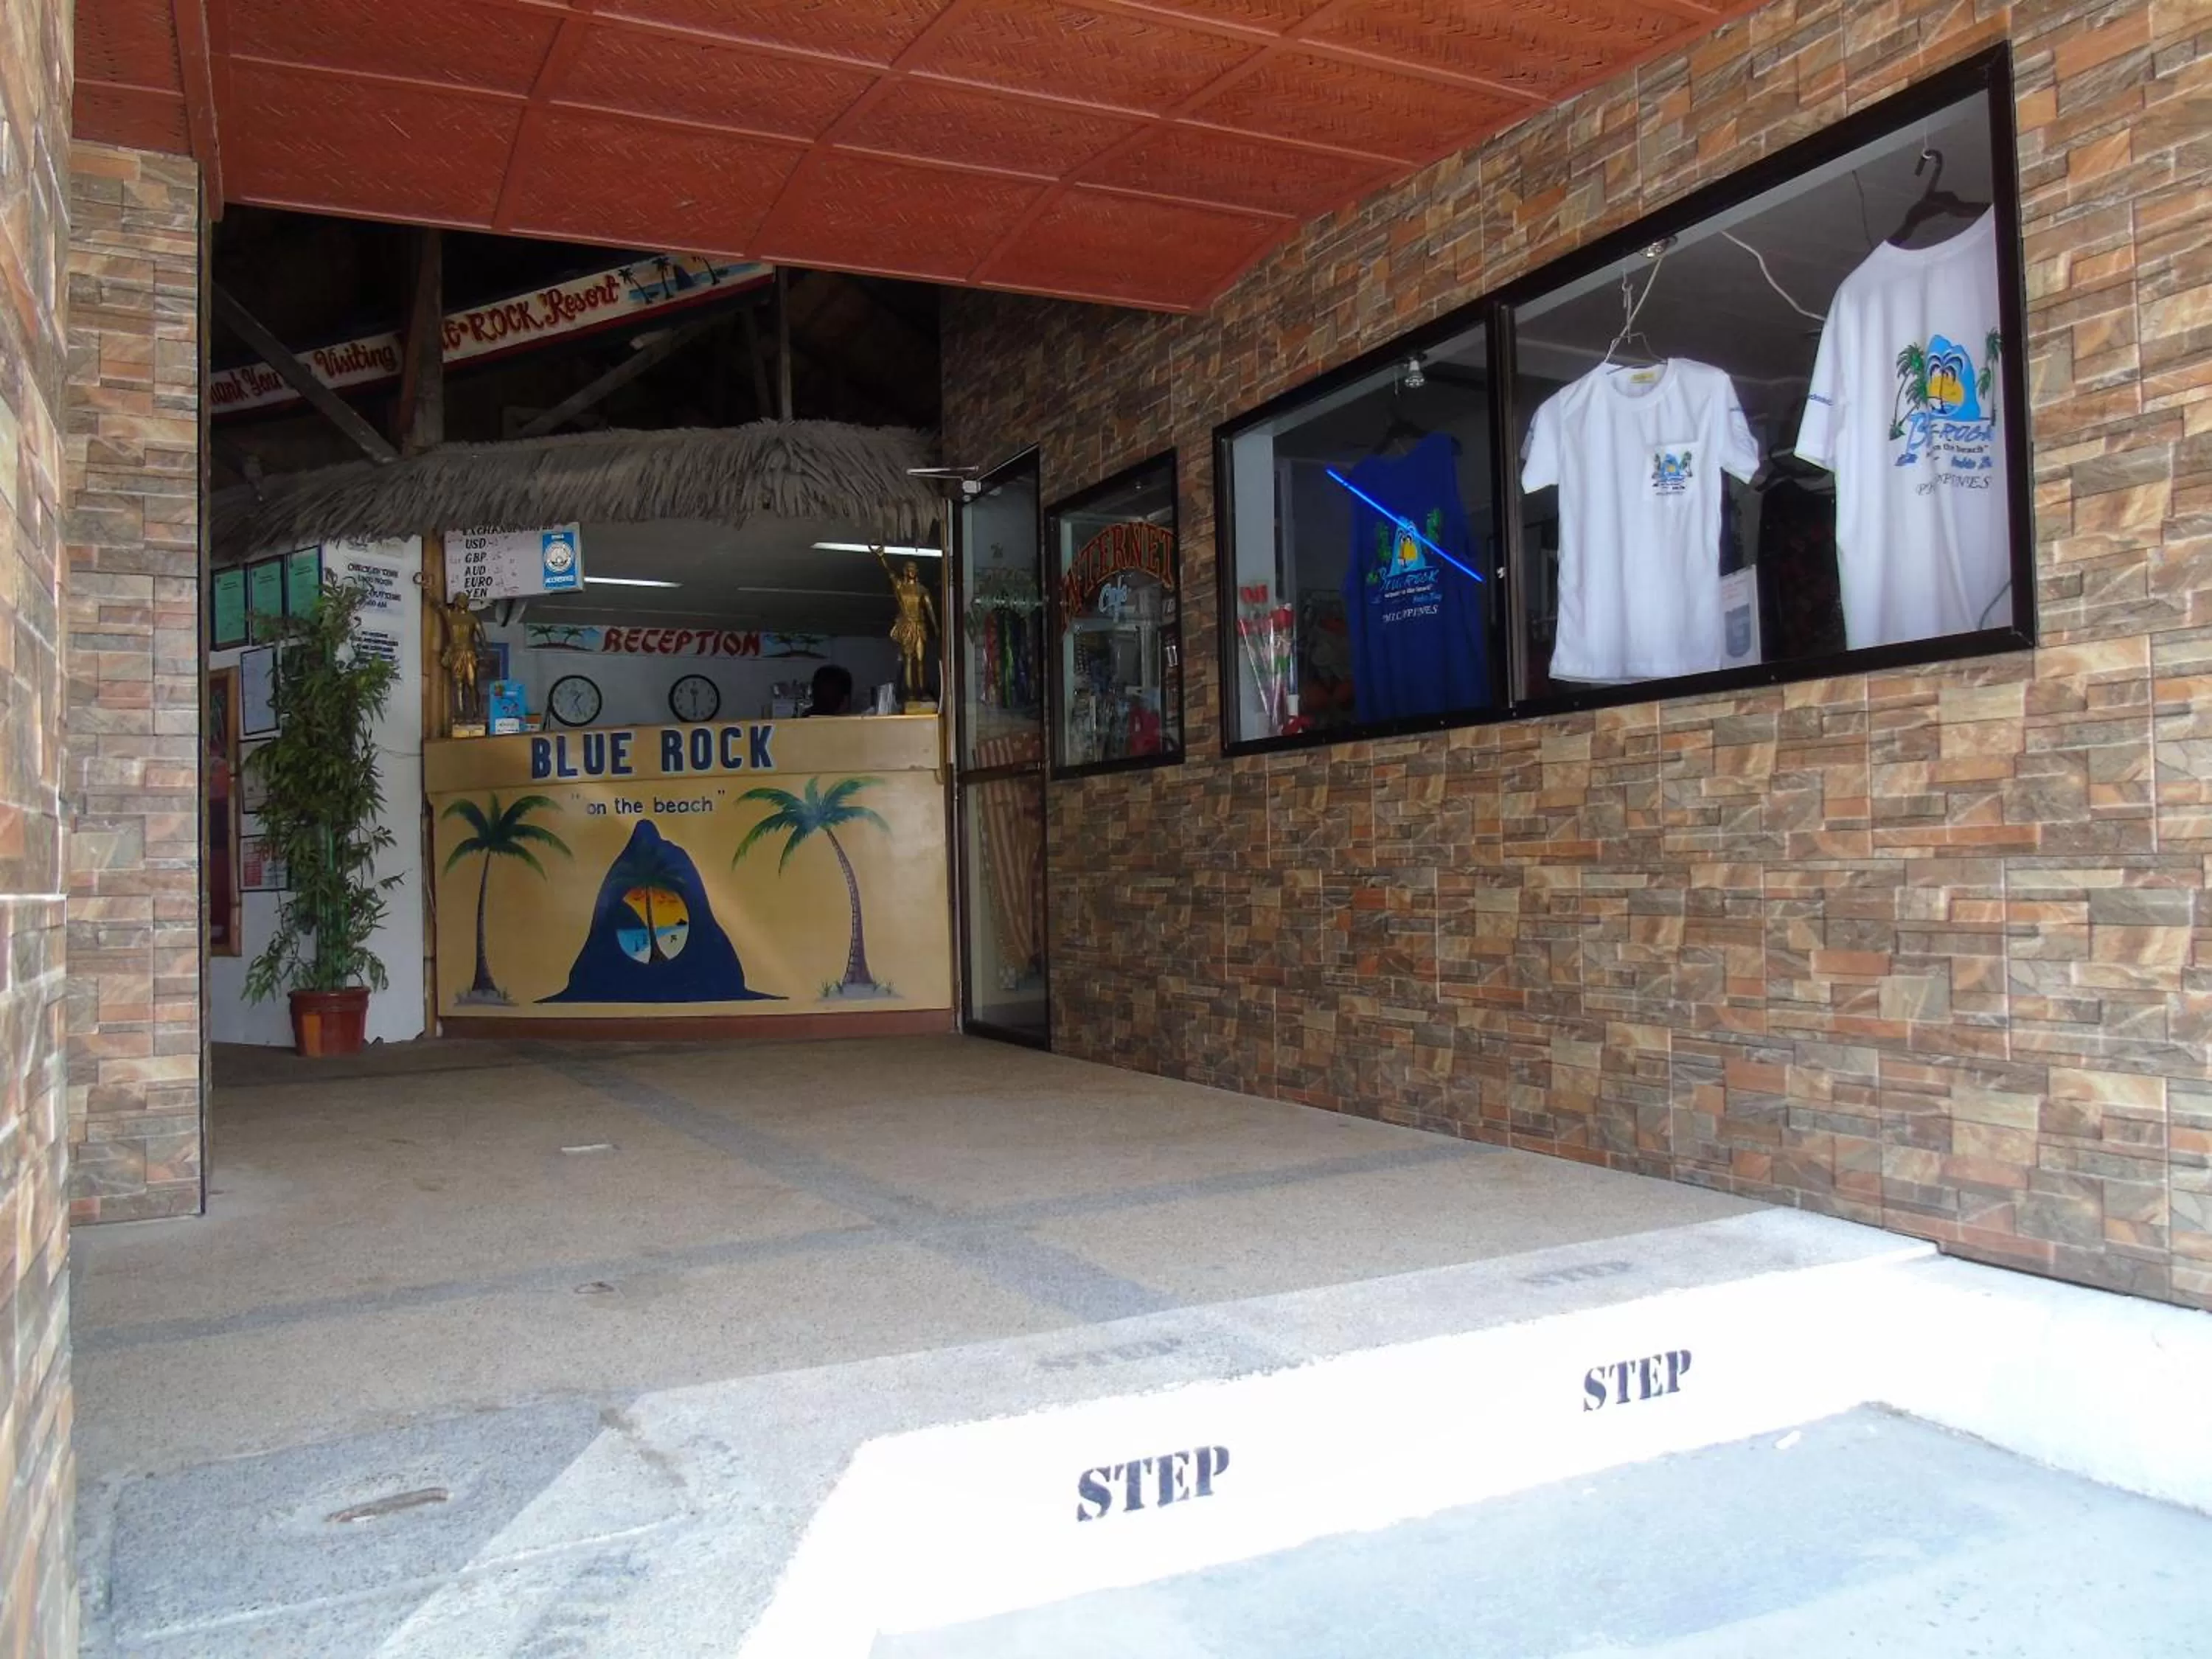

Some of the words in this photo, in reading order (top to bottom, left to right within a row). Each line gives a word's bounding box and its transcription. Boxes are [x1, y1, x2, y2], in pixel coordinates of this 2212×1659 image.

[314, 342, 397, 378] Visiting
[541, 274, 622, 325] Resort
[465, 538, 487, 549] USD
[465, 552, 487, 564] GBP
[464, 566, 487, 577] AUD
[464, 577, 493, 588] EURO
[1060, 521, 1178, 638] INTERNET
[601, 627, 762, 657] RECEPTION
[531, 731, 633, 779] BLUE
[661, 725, 774, 772] ROCK
[614, 797, 644, 815] the
[1582, 1349, 1693, 1413] STEP
[1075, 1444, 1231, 1523] STEP
